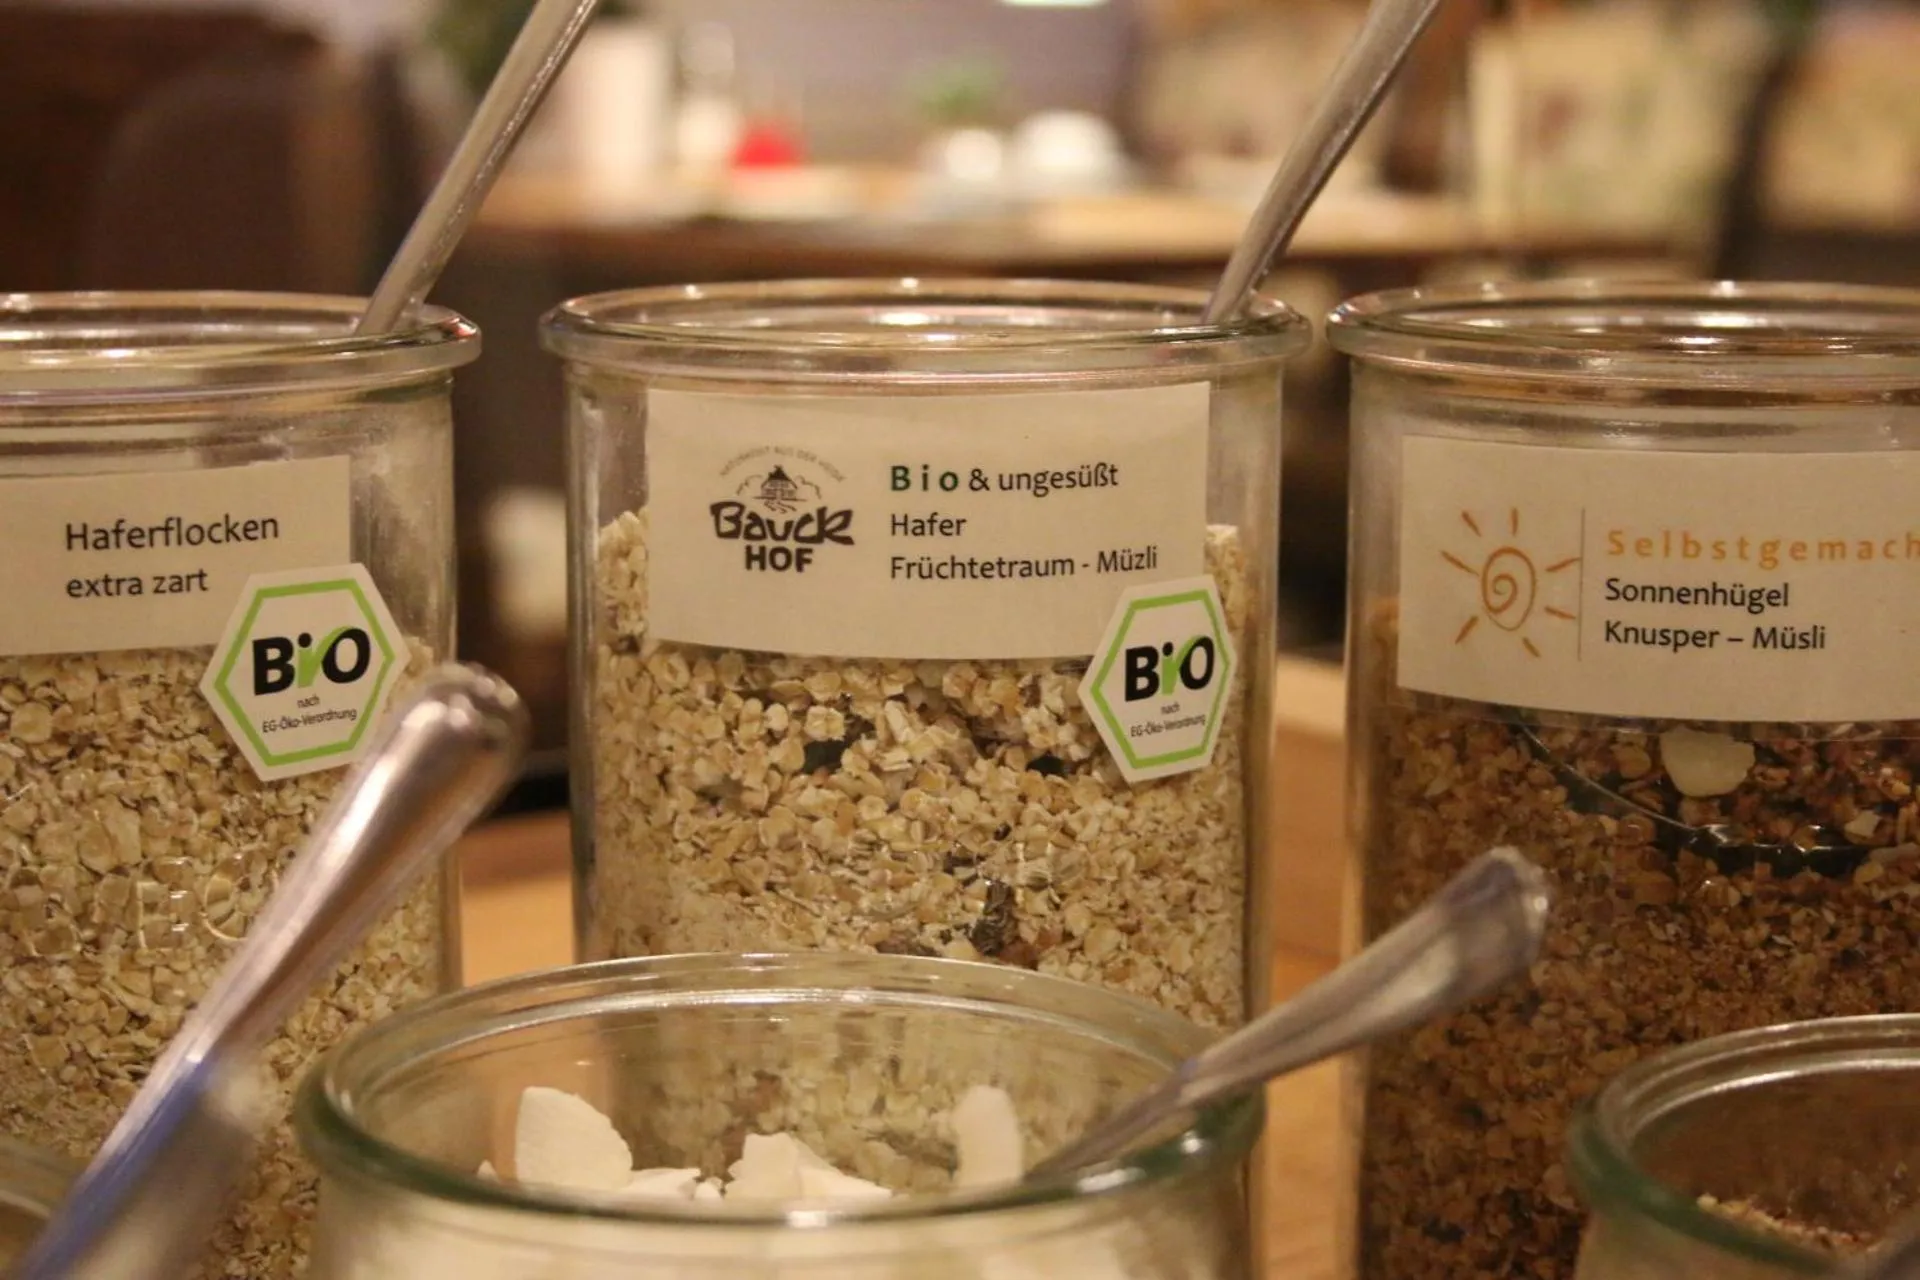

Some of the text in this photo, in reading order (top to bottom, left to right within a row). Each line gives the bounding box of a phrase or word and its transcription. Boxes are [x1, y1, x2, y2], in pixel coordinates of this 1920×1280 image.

[891, 462, 1119, 498] Bio & ungesüßt
[65, 513, 279, 551] Haferflocken
[890, 512, 967, 537] Hafer
[745, 544, 813, 572] HOF
[890, 555, 1075, 580] Früchtetraum
[1096, 545, 1158, 574] Müzli
[66, 568, 208, 598] extra zart
[1605, 577, 1789, 615] Sonnenhügel
[1605, 619, 1720, 653] Knusper
[1752, 624, 1826, 650] Müsli
